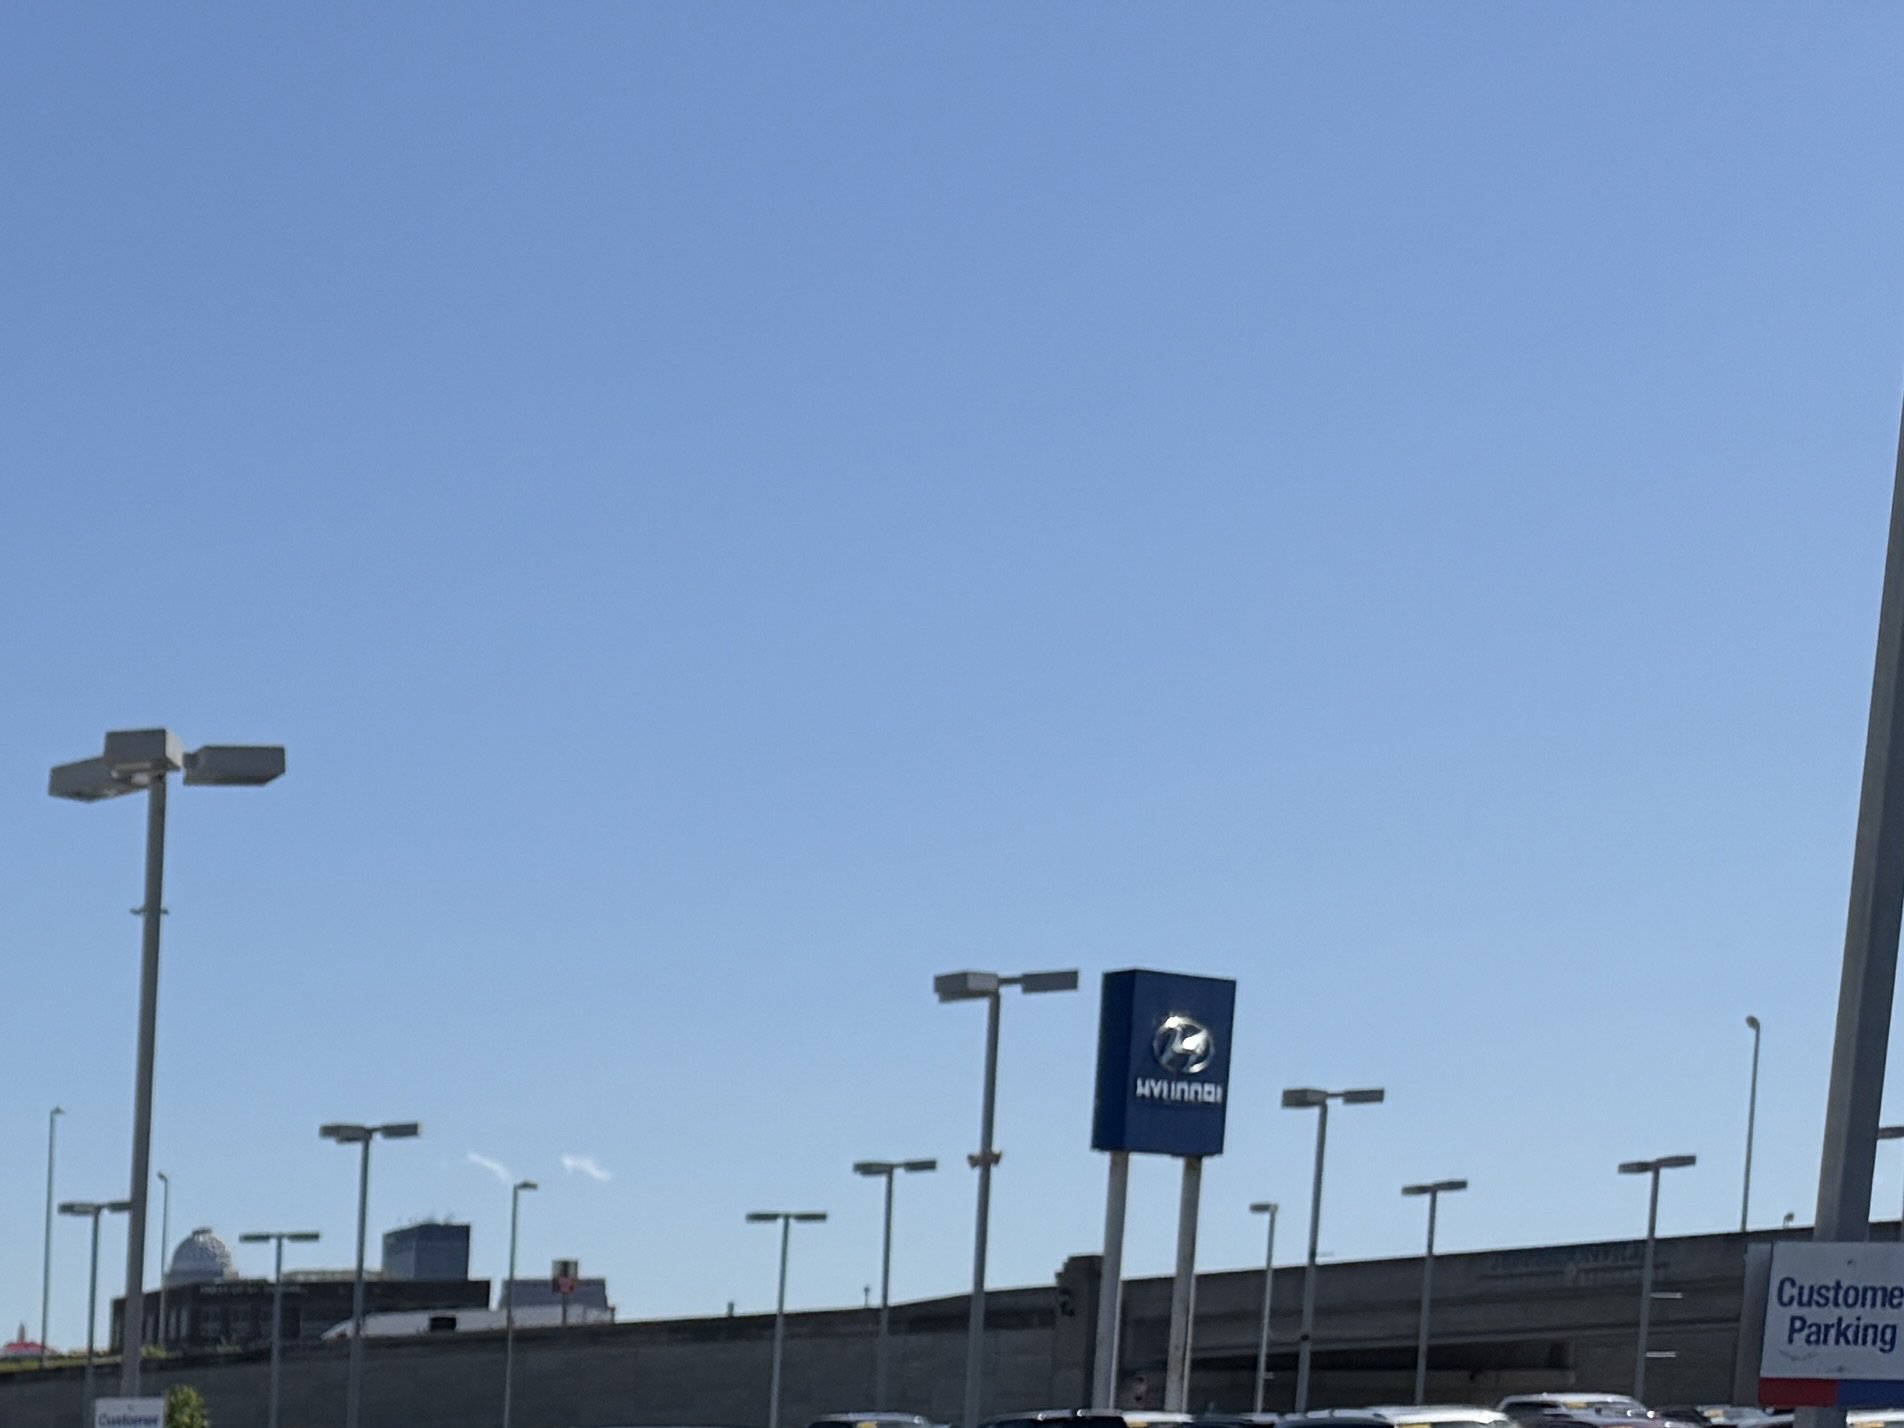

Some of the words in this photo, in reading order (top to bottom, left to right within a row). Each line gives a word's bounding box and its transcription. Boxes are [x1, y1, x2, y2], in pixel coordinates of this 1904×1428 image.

[1136, 1078, 1223, 1104] HYUNDAI
[1788, 1315, 1897, 1353] Parking
[98, 1413, 160, 1428] Customer
